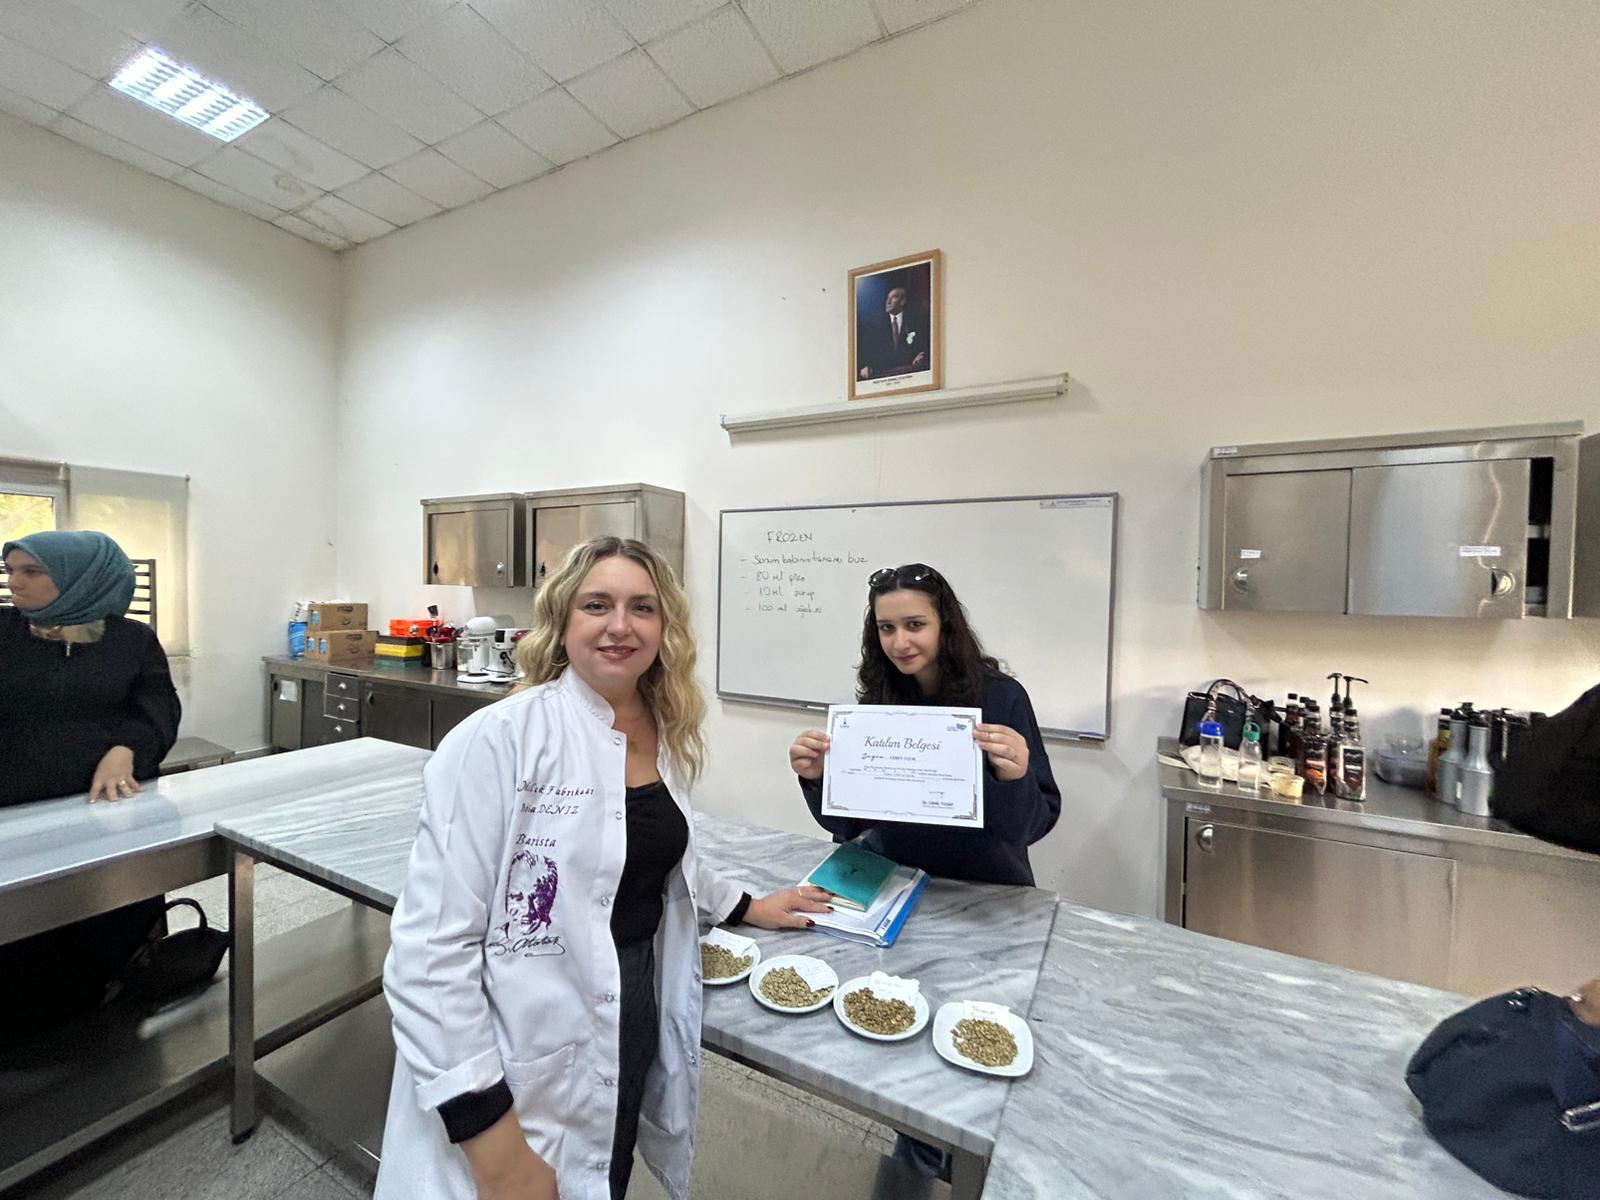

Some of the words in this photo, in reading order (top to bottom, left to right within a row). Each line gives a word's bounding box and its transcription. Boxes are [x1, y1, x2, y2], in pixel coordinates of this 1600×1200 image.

[767, 531, 813, 544] FROZEN
[848, 551, 869, 564] buz
[864, 735, 900, 748] Katılım
[903, 737, 942, 752] Belgesi
[516, 833, 556, 847] Barista
